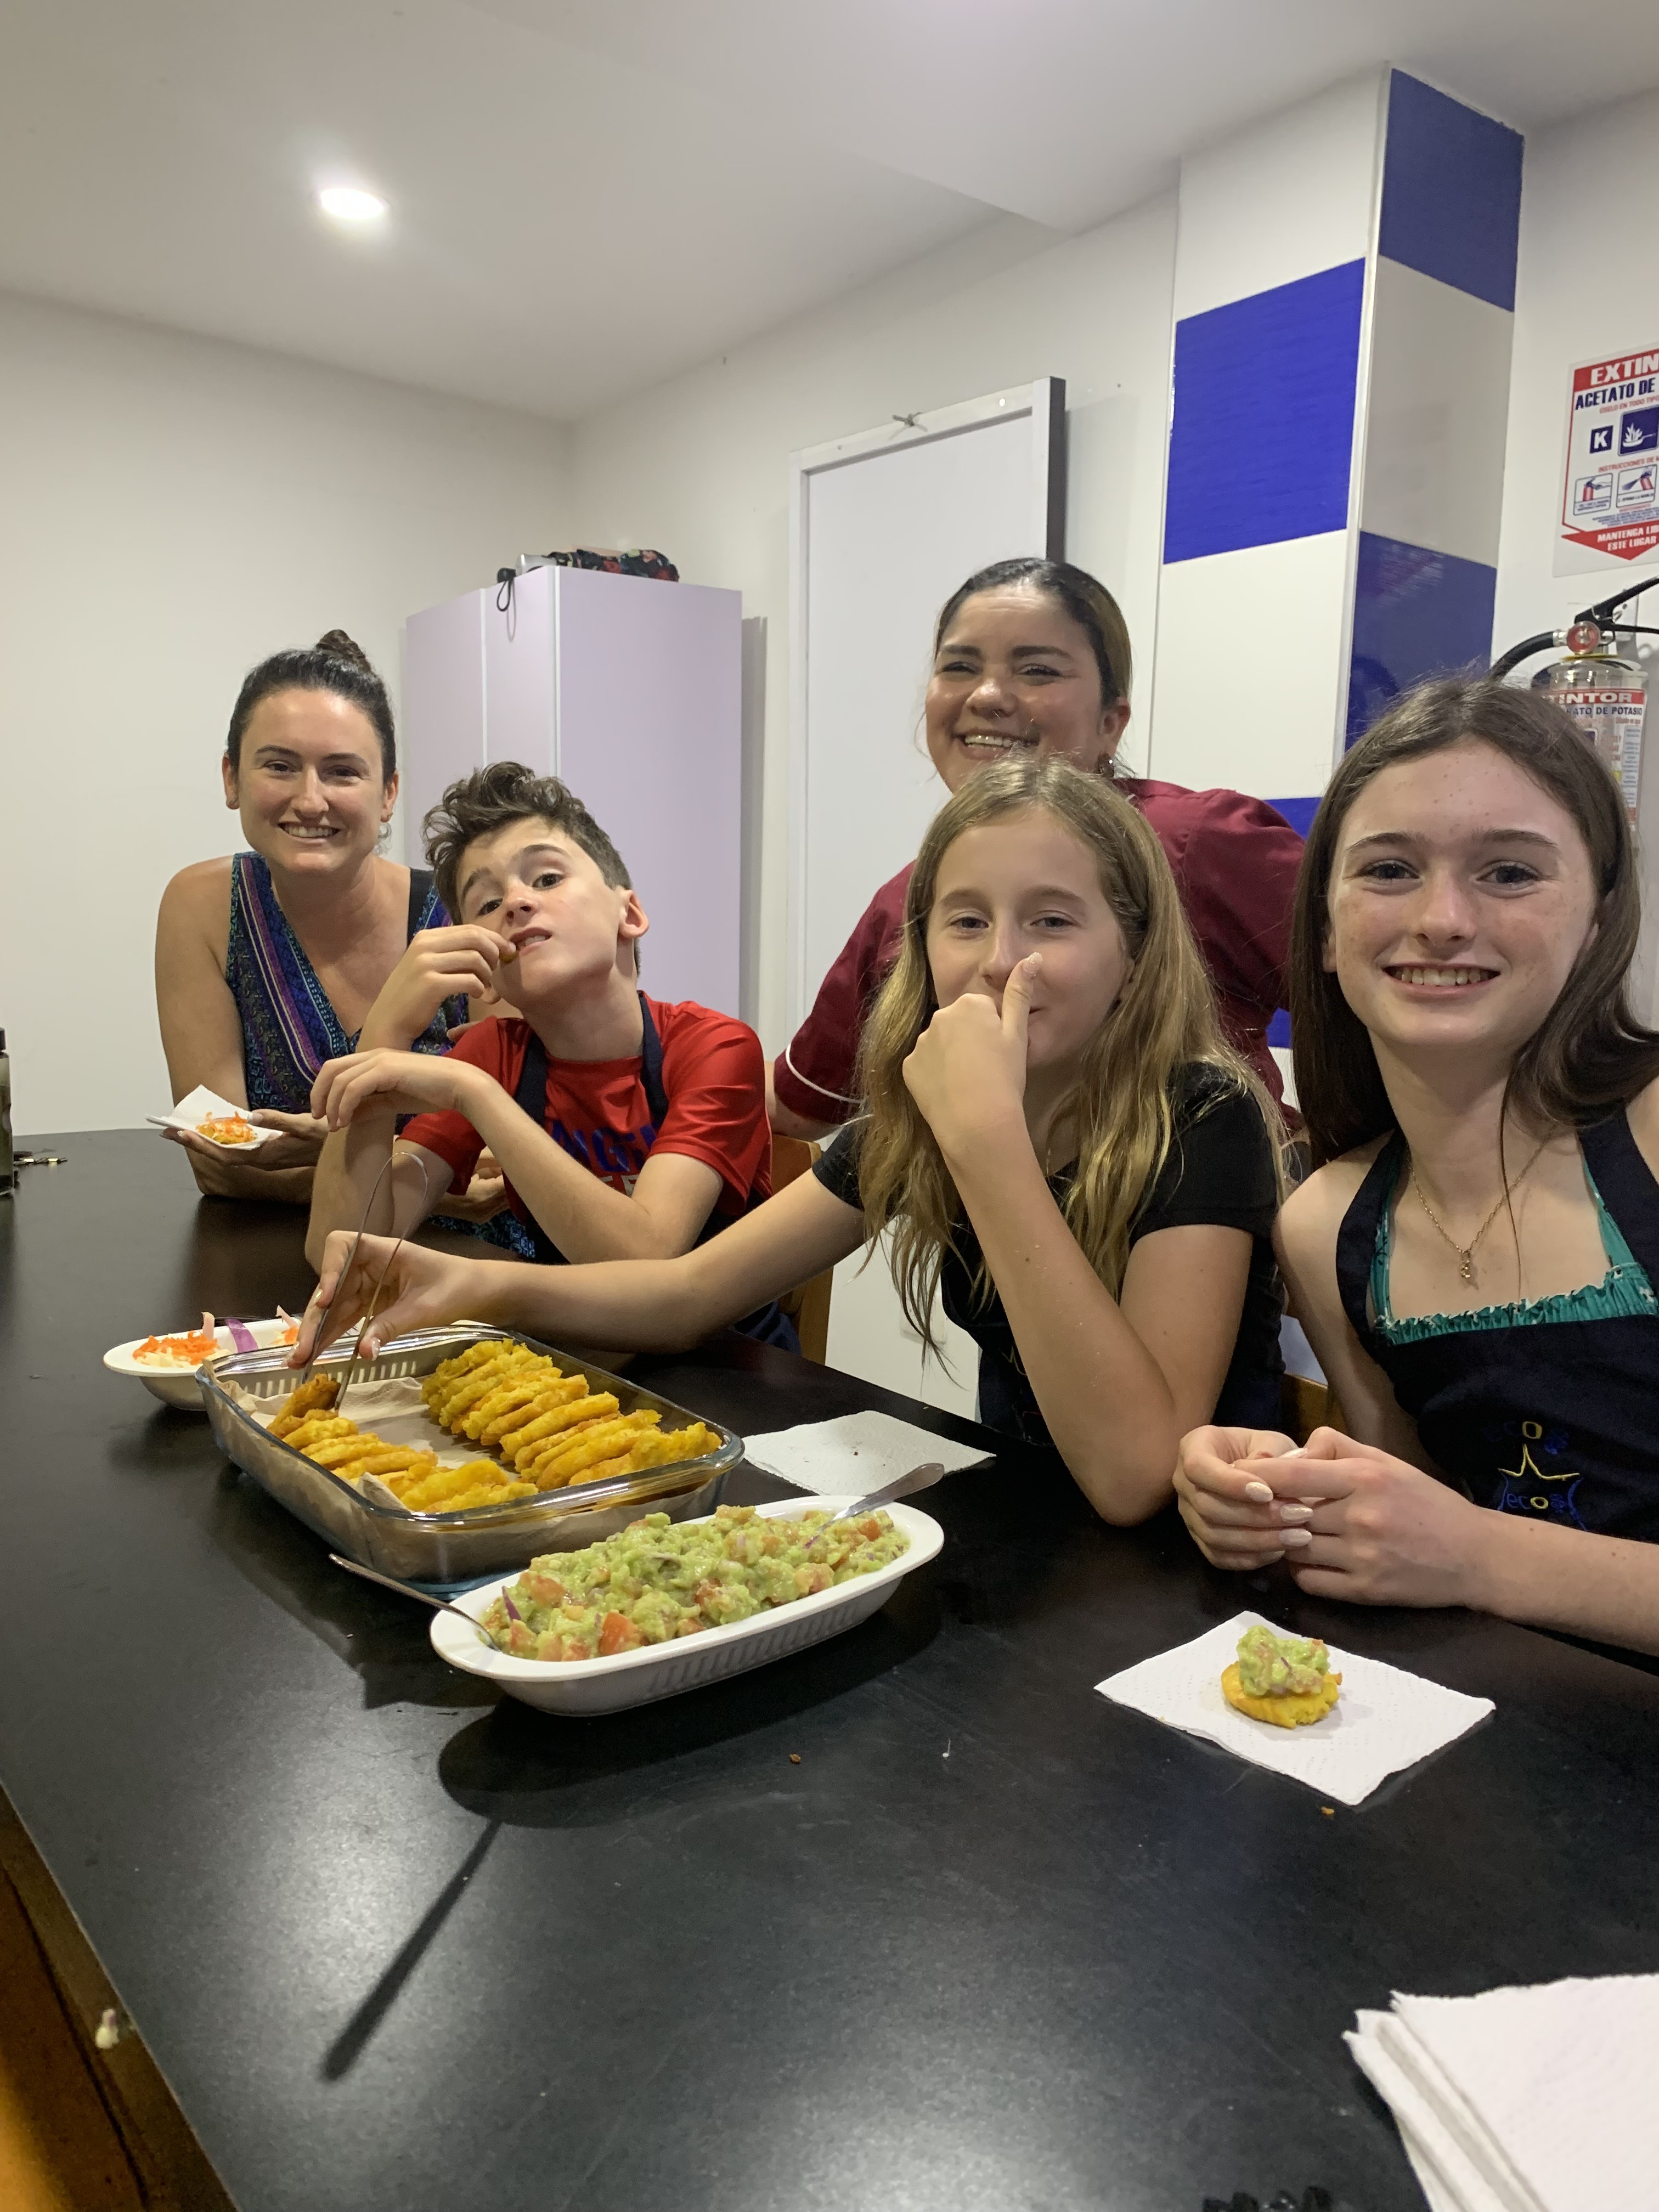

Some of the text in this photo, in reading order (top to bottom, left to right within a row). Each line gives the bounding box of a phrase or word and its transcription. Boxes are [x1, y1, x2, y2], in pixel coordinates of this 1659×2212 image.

[1591, 353, 1659, 386] EXTIN
[1575, 377, 1655, 410] ACETATO DE
[1594, 430, 1608, 449] K
[1597, 527, 1644, 543] MANTENGA
[1607, 535, 1657, 551] ESTE LUGAR
[1549, 692, 1632, 704] INTOR
[1611, 707, 1643, 716] POTASIO
